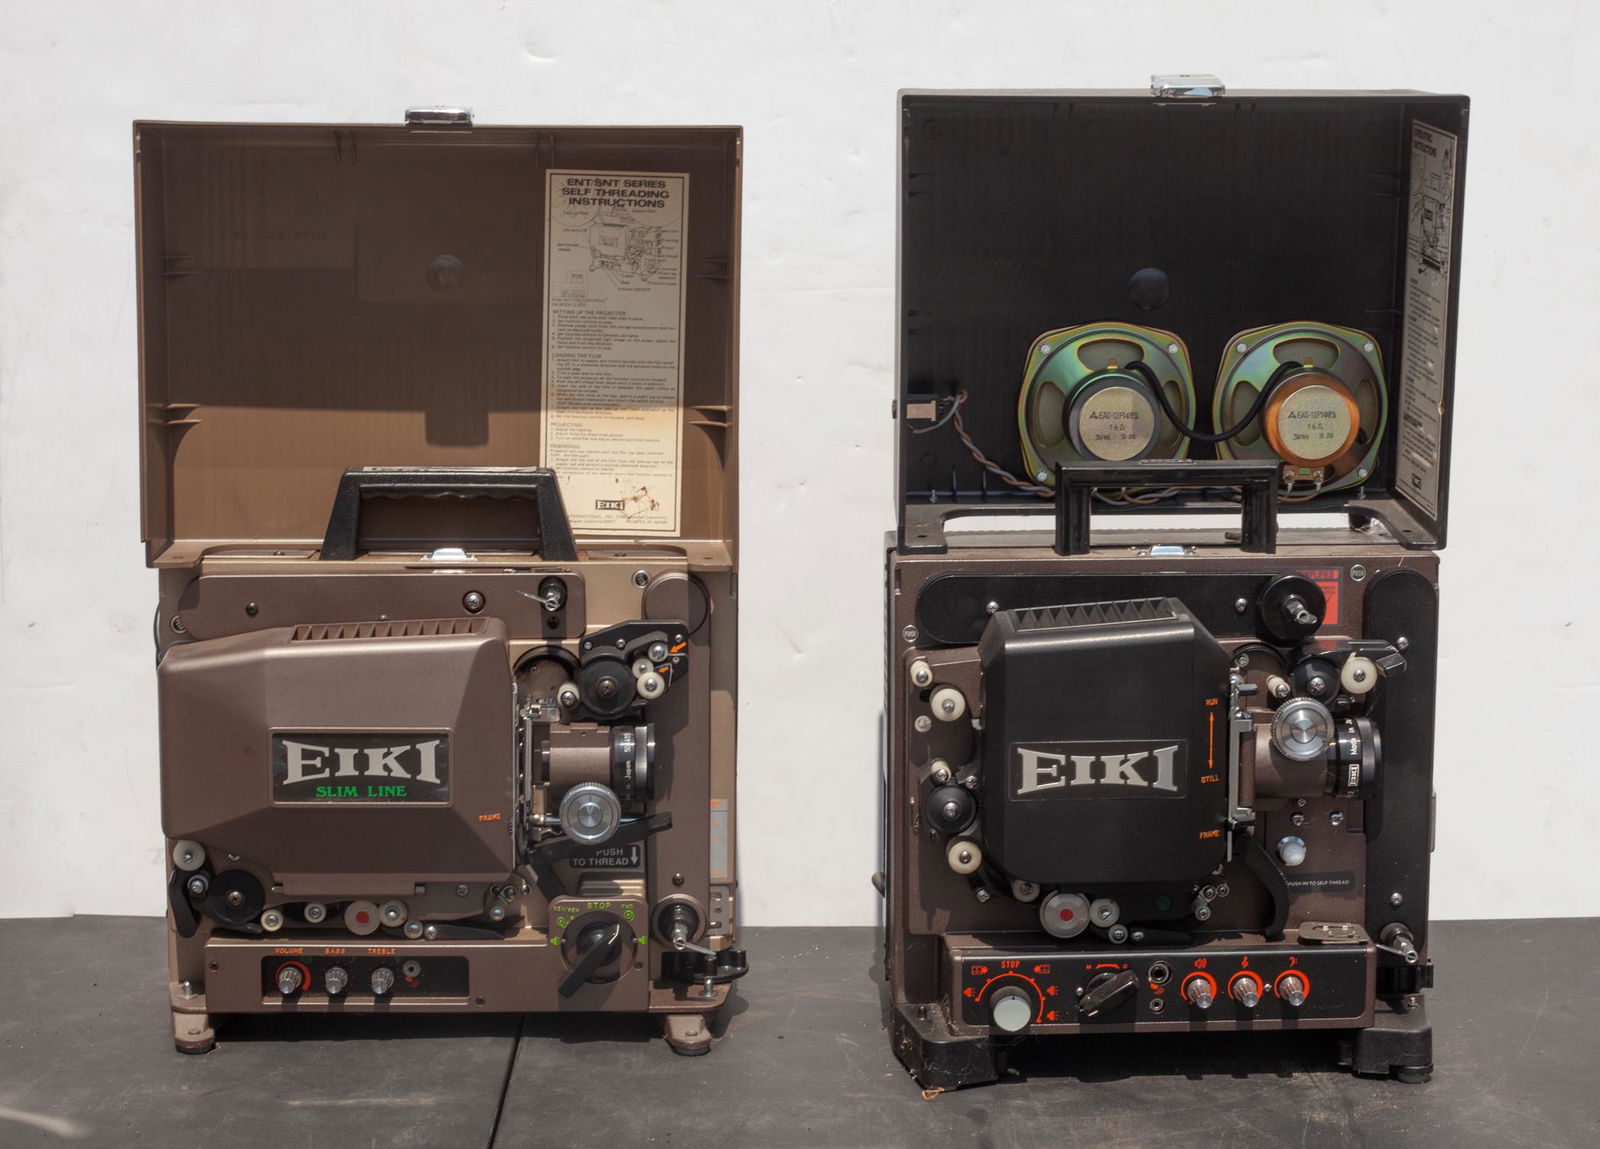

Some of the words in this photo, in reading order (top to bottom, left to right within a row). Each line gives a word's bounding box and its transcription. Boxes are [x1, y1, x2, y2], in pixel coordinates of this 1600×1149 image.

[567, 178, 620, 187] ENT/SNT
[624, 179, 666, 188] SERIES
[562, 187, 591, 196] SELF
[596, 188, 670, 199] THREADING
[569, 197, 665, 208] INSTRUCTIONS
[282, 739, 441, 785] EIKI
[624, 760, 632, 779] Japan
[1017, 744, 1178, 795] EIKI
[316, 785, 359, 798] SLIM
[367, 785, 408, 798] LINE
[1200, 829, 1220, 840] FRAME
[596, 847, 624, 857] PUSH
[573, 858, 586, 866] TO
[589, 857, 629, 866] THREAD
[1001, 960, 1020, 969] STOP
